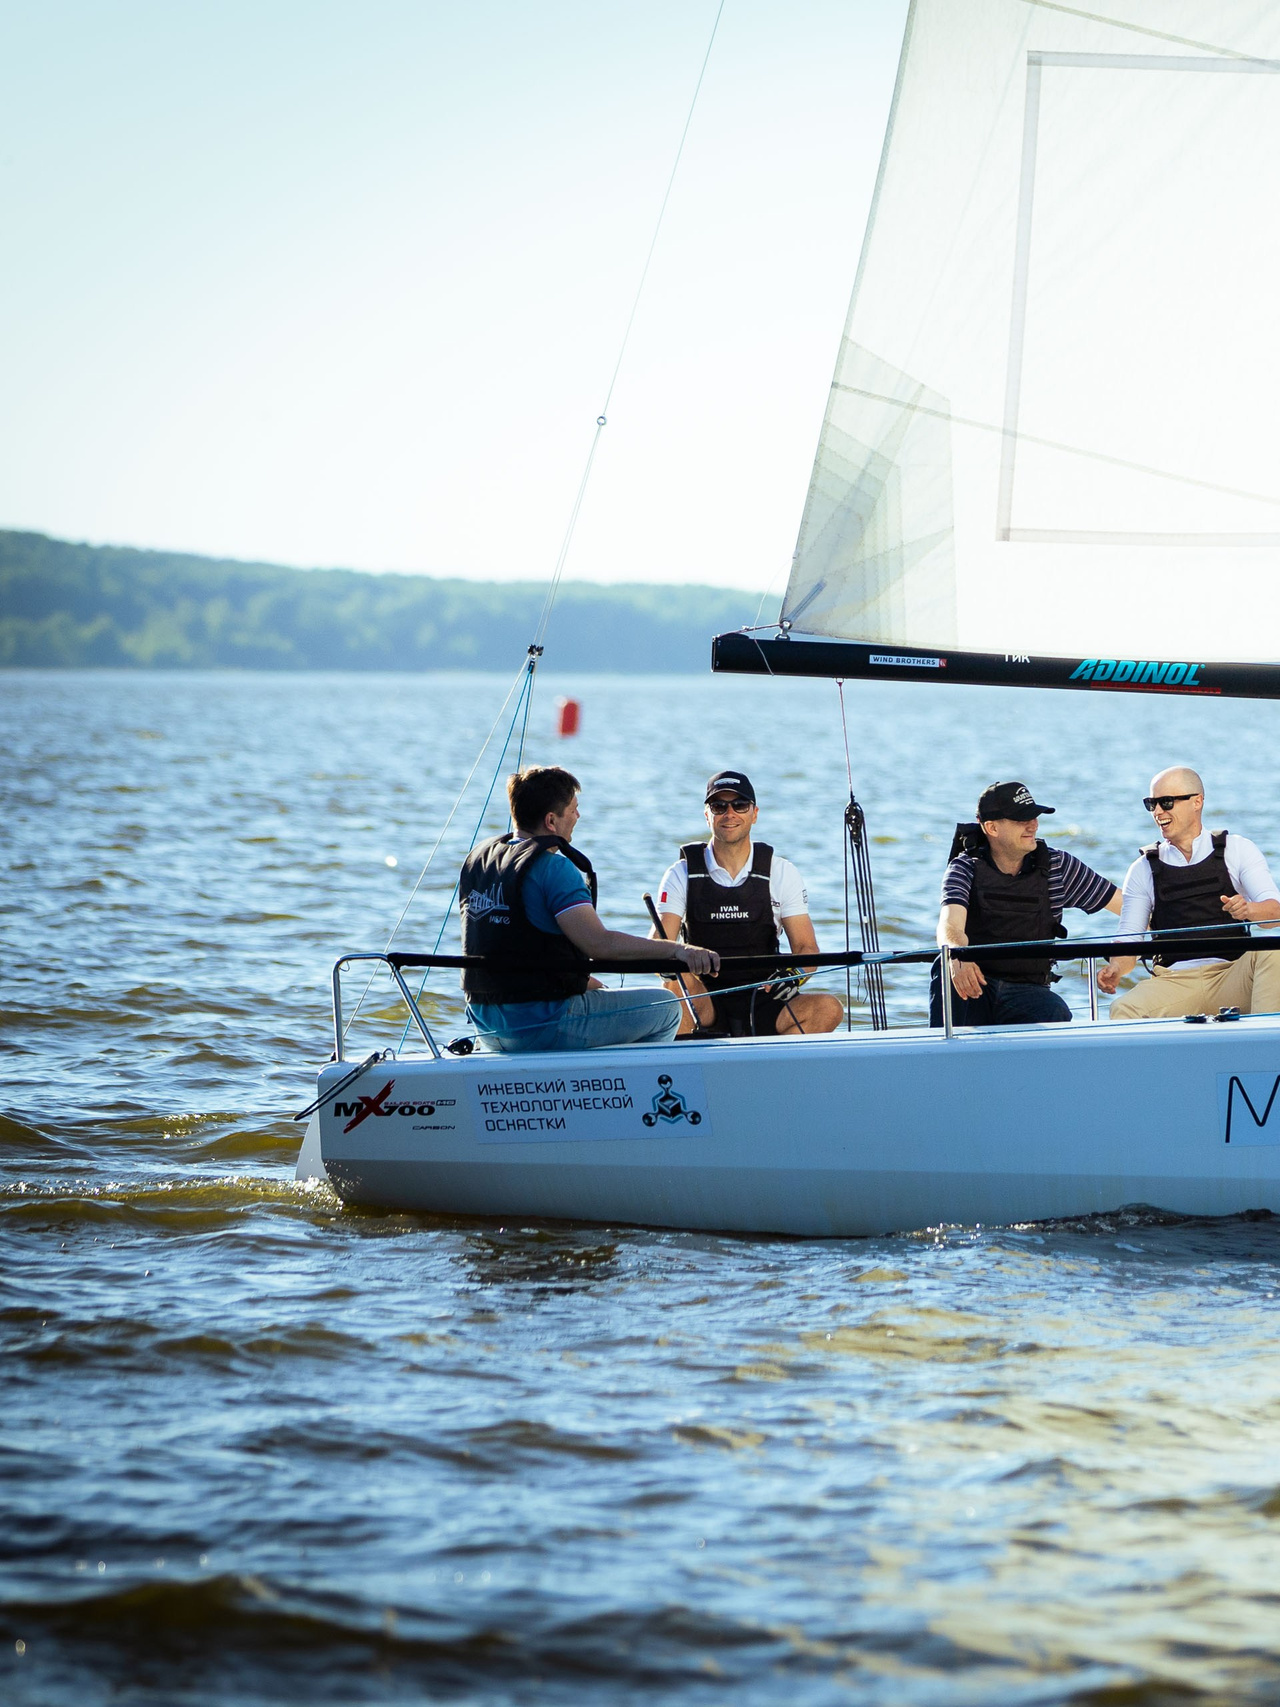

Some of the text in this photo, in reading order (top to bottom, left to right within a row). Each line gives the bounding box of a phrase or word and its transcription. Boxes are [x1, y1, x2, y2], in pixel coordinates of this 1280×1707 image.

[873, 656, 936, 666] WIND BROTHERS
[1069, 658, 1201, 686] ADDINOL
[710, 911, 749, 920] PINCHUK
[477, 1077, 627, 1096] ИЖЕВСКИЙ ЗАВОД
[481, 1093, 634, 1114] ТЕХНОЛОГИЧЕСКОЙ
[485, 1117, 567, 1132] ОСНАСТКИ
